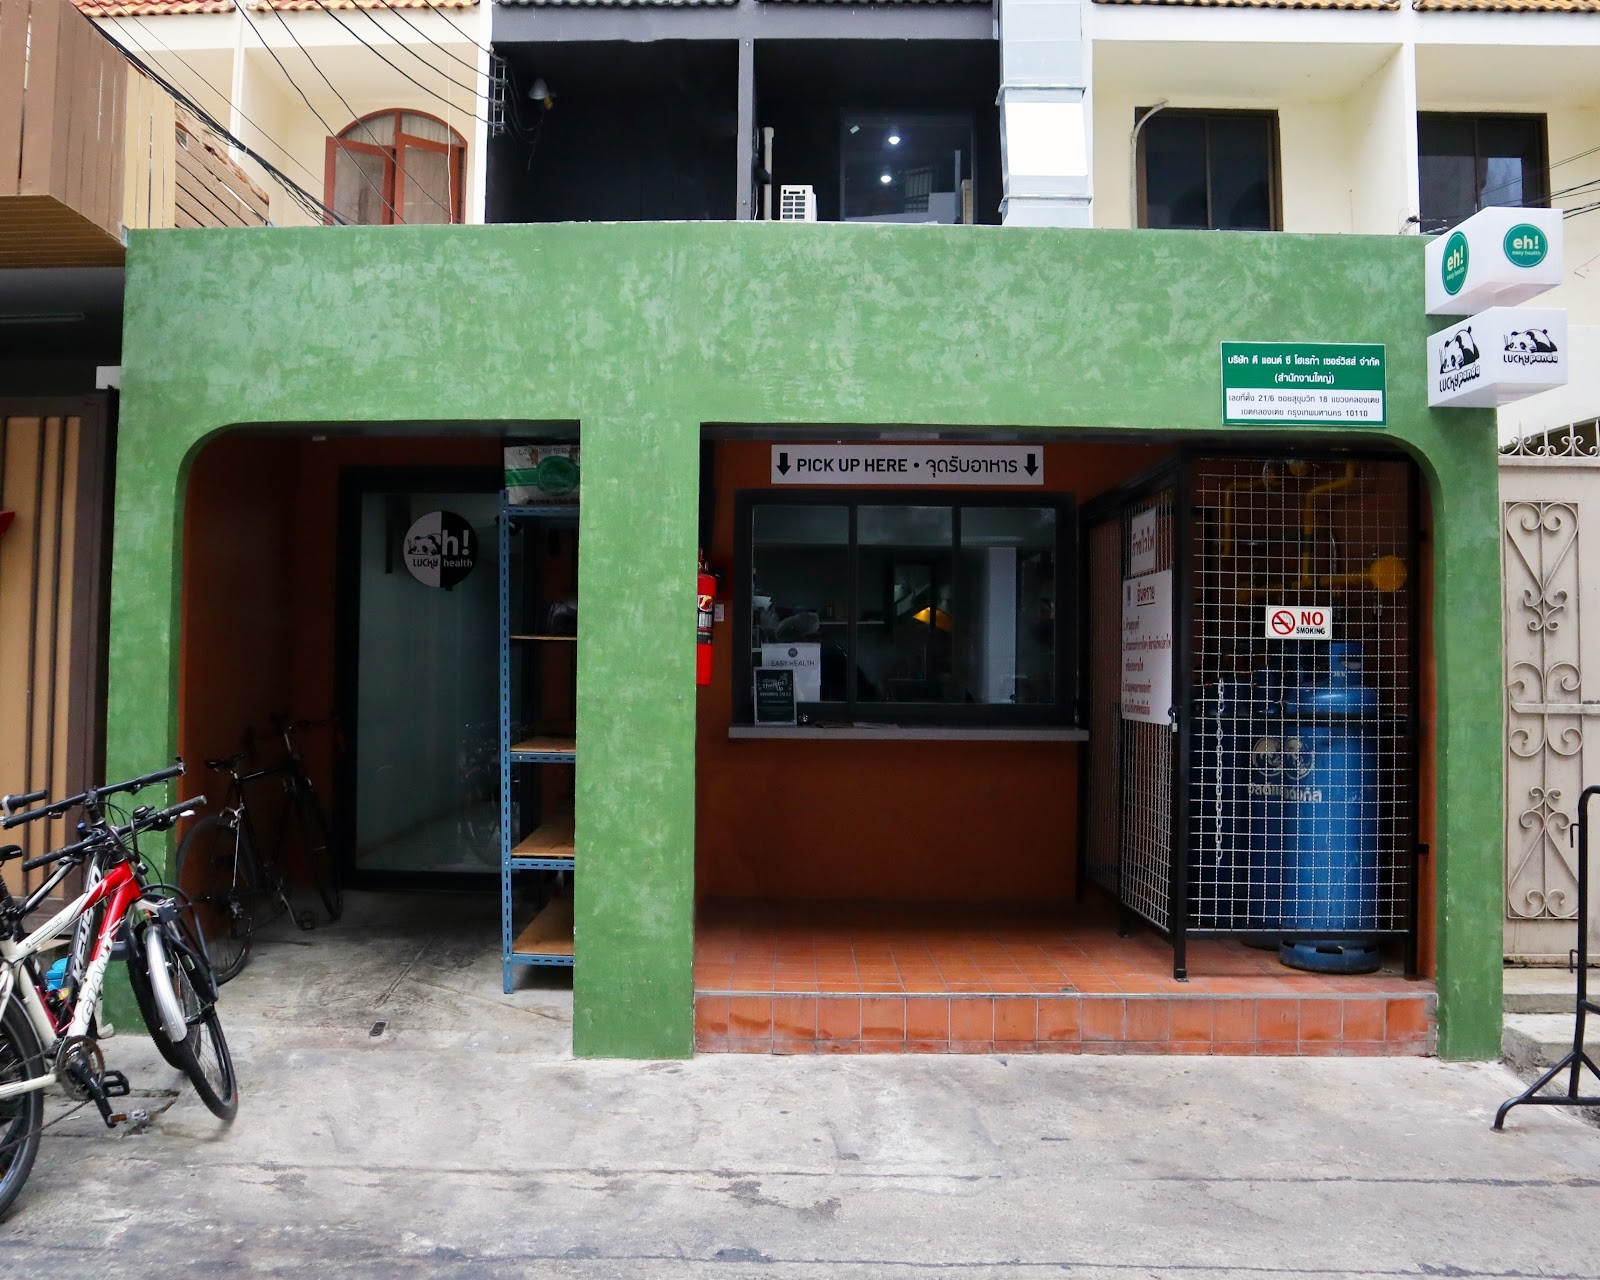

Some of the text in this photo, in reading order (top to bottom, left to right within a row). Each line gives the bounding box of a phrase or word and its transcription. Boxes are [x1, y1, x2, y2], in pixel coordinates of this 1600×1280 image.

[1513, 235, 1539, 249] eh!
[1447, 245, 1463, 271] eh!
[1228, 354, 1249, 365] บริษัท
[1262, 354, 1283, 365] แอนด์
[1360, 356, 1380, 367] จำกัด
[1275, 371, 1335, 384] (สำนักงานใหญ่)
[1258, 394, 1275, 402] 21/6
[1319, 395, 1328, 403] 18
[797, 455, 1018, 478] PICK UP HERE จุดรับอาหาร
[443, 558, 473, 568] health
[1300, 611, 1324, 626] NO
[1295, 626, 1326, 635] SMOKING
[81, 931, 113, 1026] GIANT
